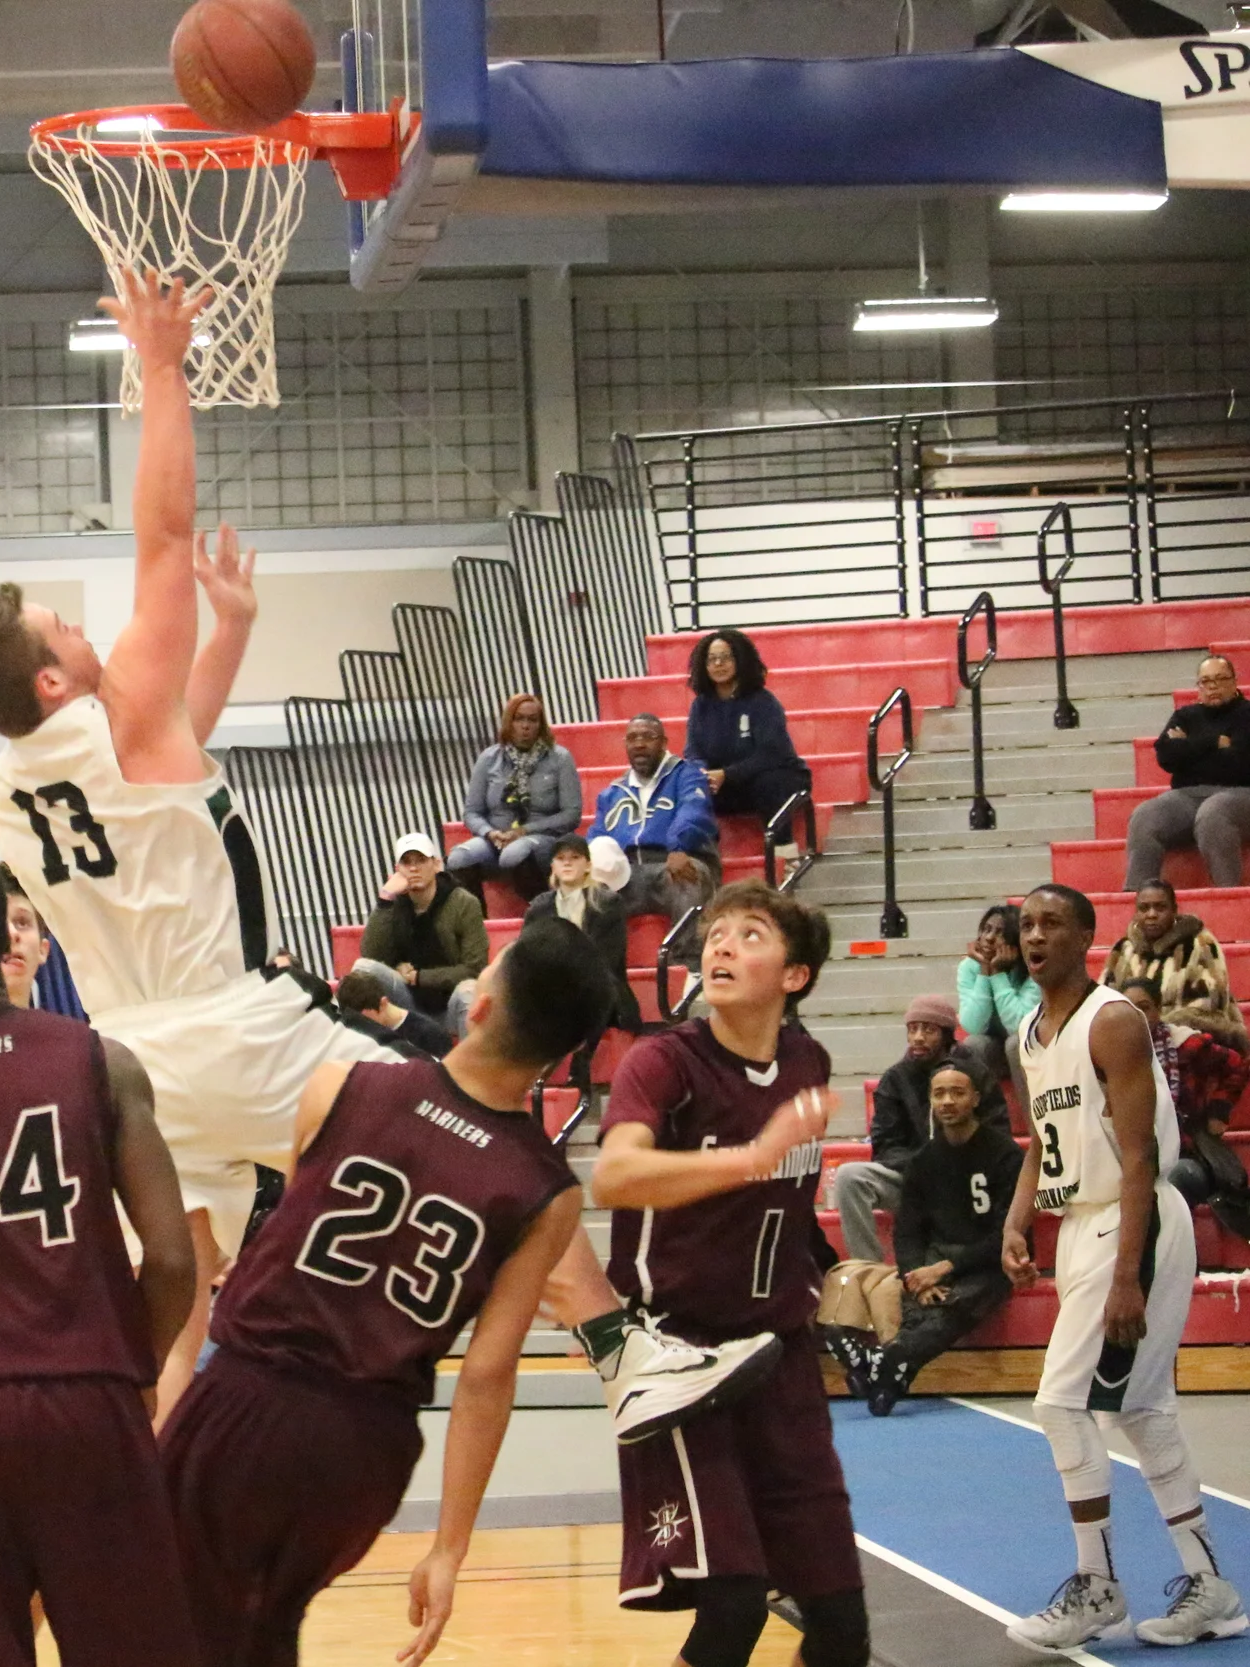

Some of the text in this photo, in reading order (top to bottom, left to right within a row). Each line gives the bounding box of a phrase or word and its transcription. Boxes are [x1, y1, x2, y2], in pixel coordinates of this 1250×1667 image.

[10, 780, 118, 886] 13
[414, 1099, 494, 1149] MARINERS
[1042, 1122, 1065, 1178] 3
[970, 1172, 991, 1214] S
[294, 1155, 485, 1329] 23
[752, 1209, 784, 1298] 1
